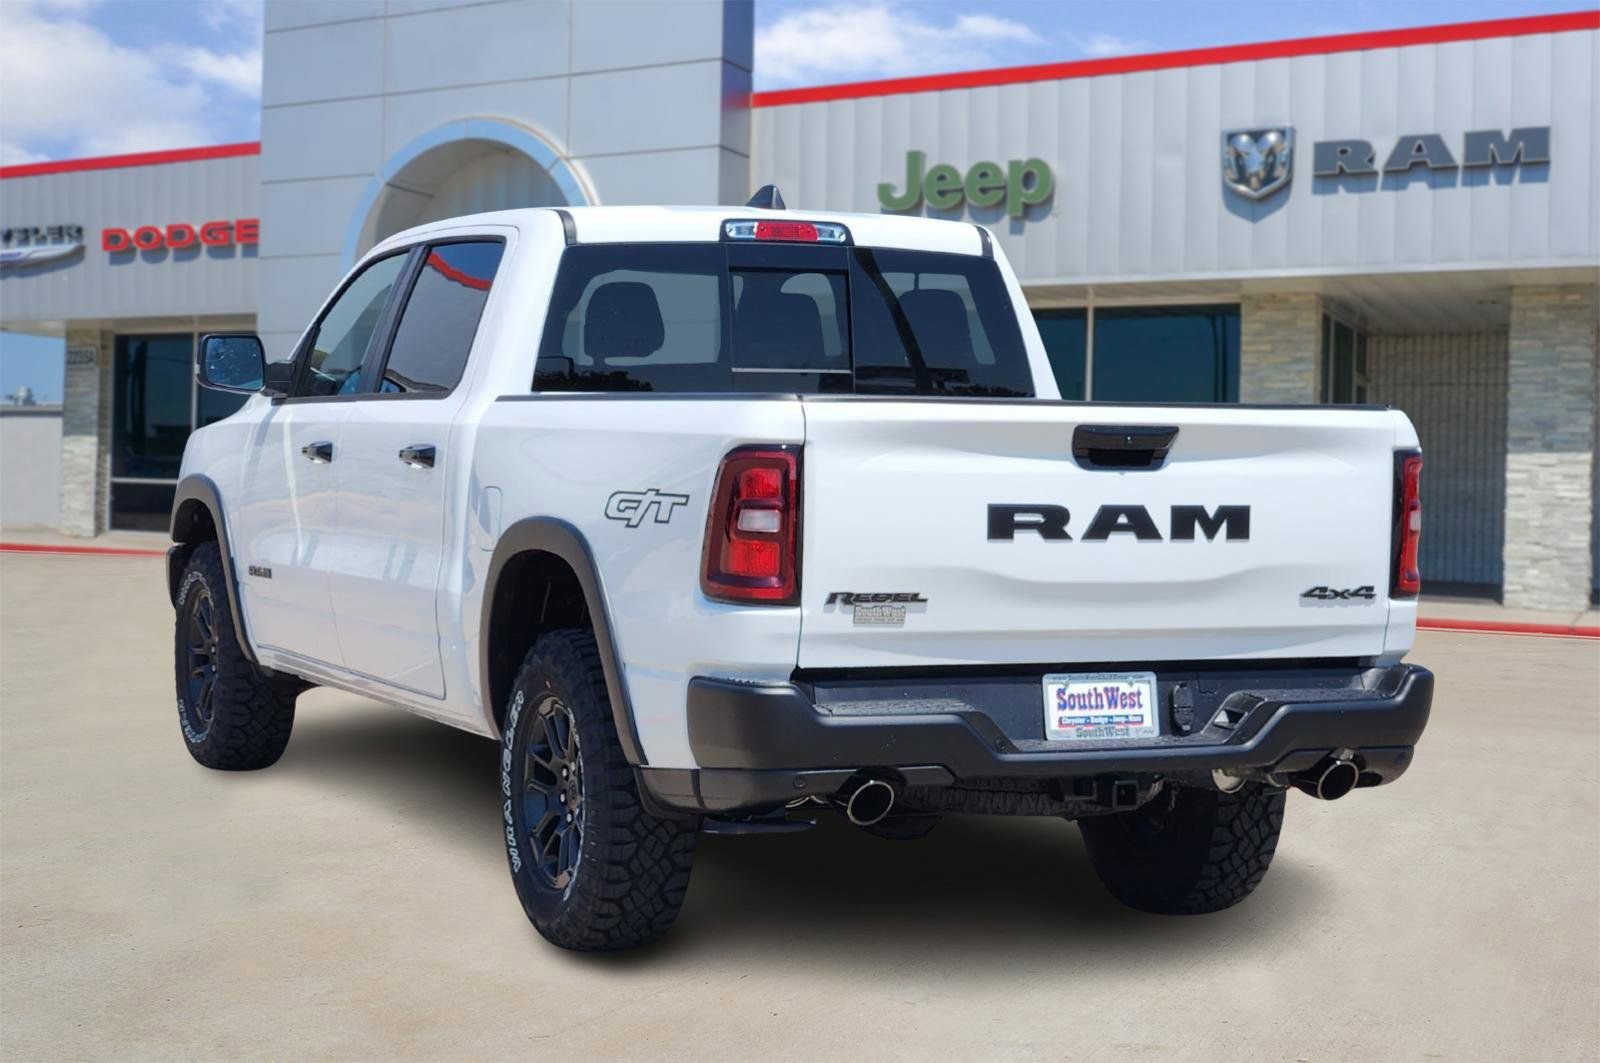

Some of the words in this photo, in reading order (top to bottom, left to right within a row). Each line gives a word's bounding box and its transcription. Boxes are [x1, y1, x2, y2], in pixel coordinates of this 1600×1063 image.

[1312, 126, 1550, 176] RAM
[877, 150, 1053, 218] Jeep
[102, 218, 260, 252] DODGE
[987, 503, 1251, 542] RAM
[1299, 585, 1376, 600] 4x4
[1056, 686, 1143, 712] SouthWest
[1077, 727, 1130, 738] SouthWest
